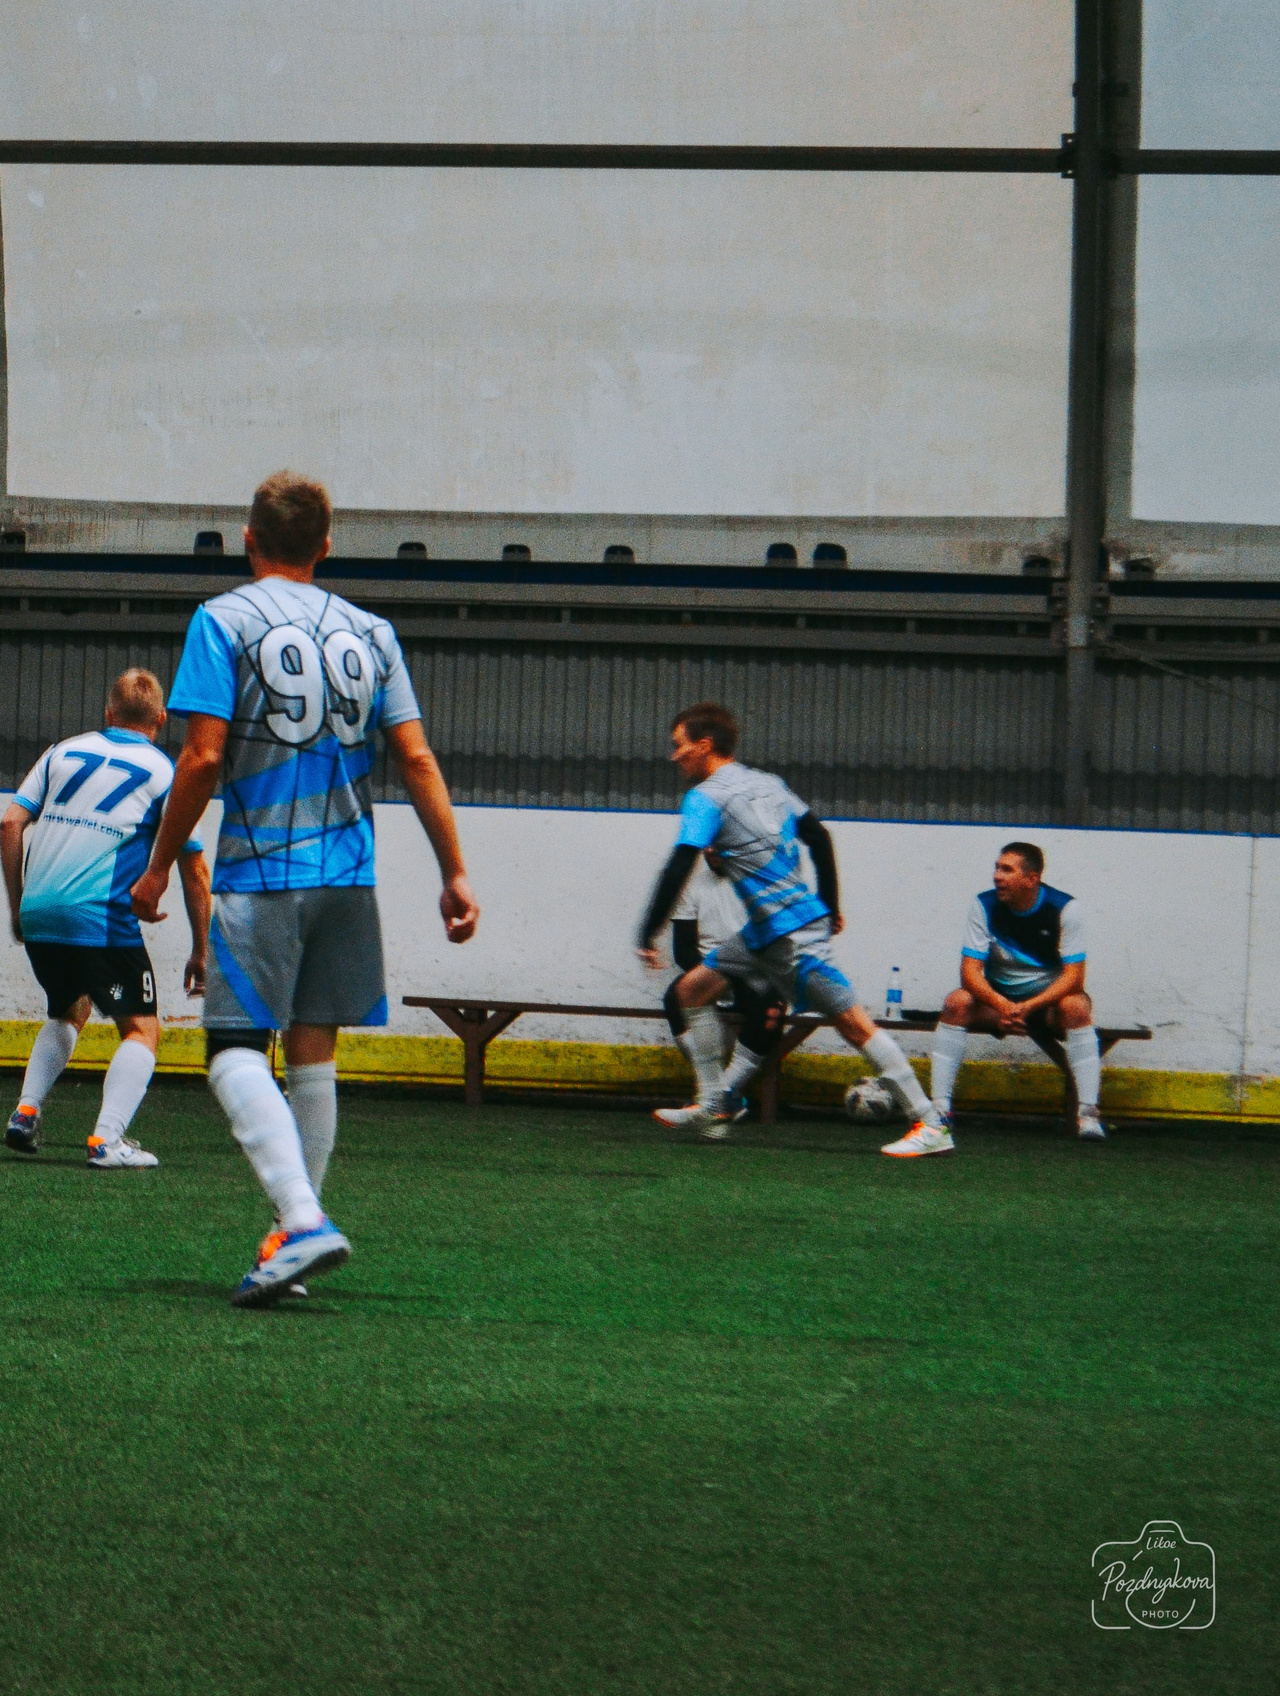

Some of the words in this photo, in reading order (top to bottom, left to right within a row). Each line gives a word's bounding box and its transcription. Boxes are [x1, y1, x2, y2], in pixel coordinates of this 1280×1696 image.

[258, 623, 377, 748] 99
[53, 750, 152, 814] 77
[143, 970, 153, 1003] 9
